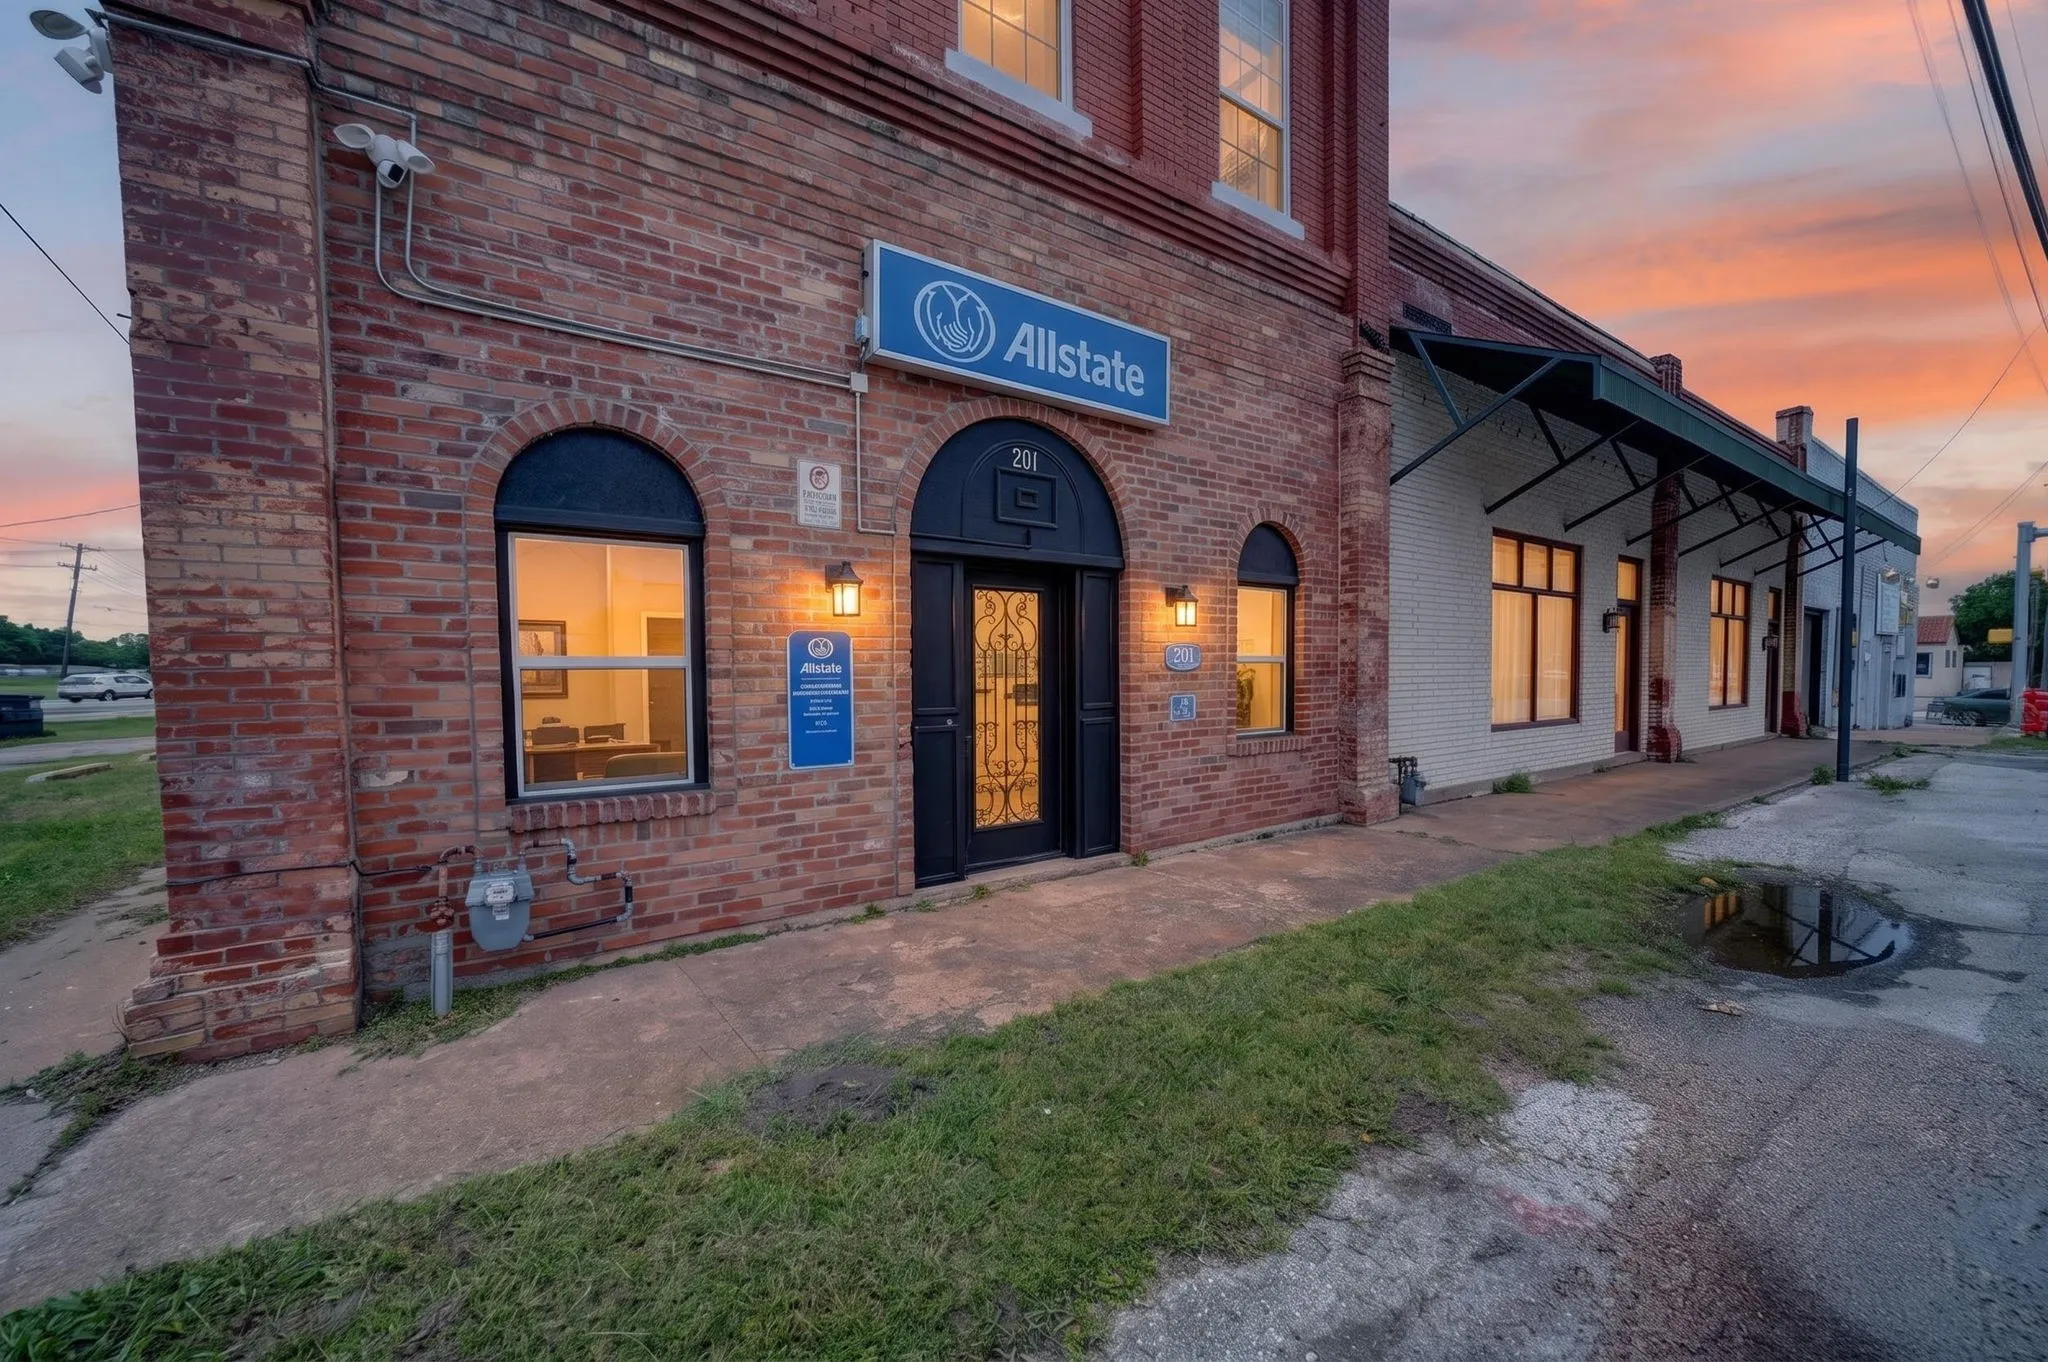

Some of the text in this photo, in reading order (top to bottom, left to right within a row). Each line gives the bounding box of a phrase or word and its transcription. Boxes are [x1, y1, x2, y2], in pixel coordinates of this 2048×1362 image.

[1003, 323, 1145, 396] Allstate
[1012, 447, 1038, 472] 201
[1173, 647, 1194, 663] 201
[800, 662, 842, 674] Allstate
